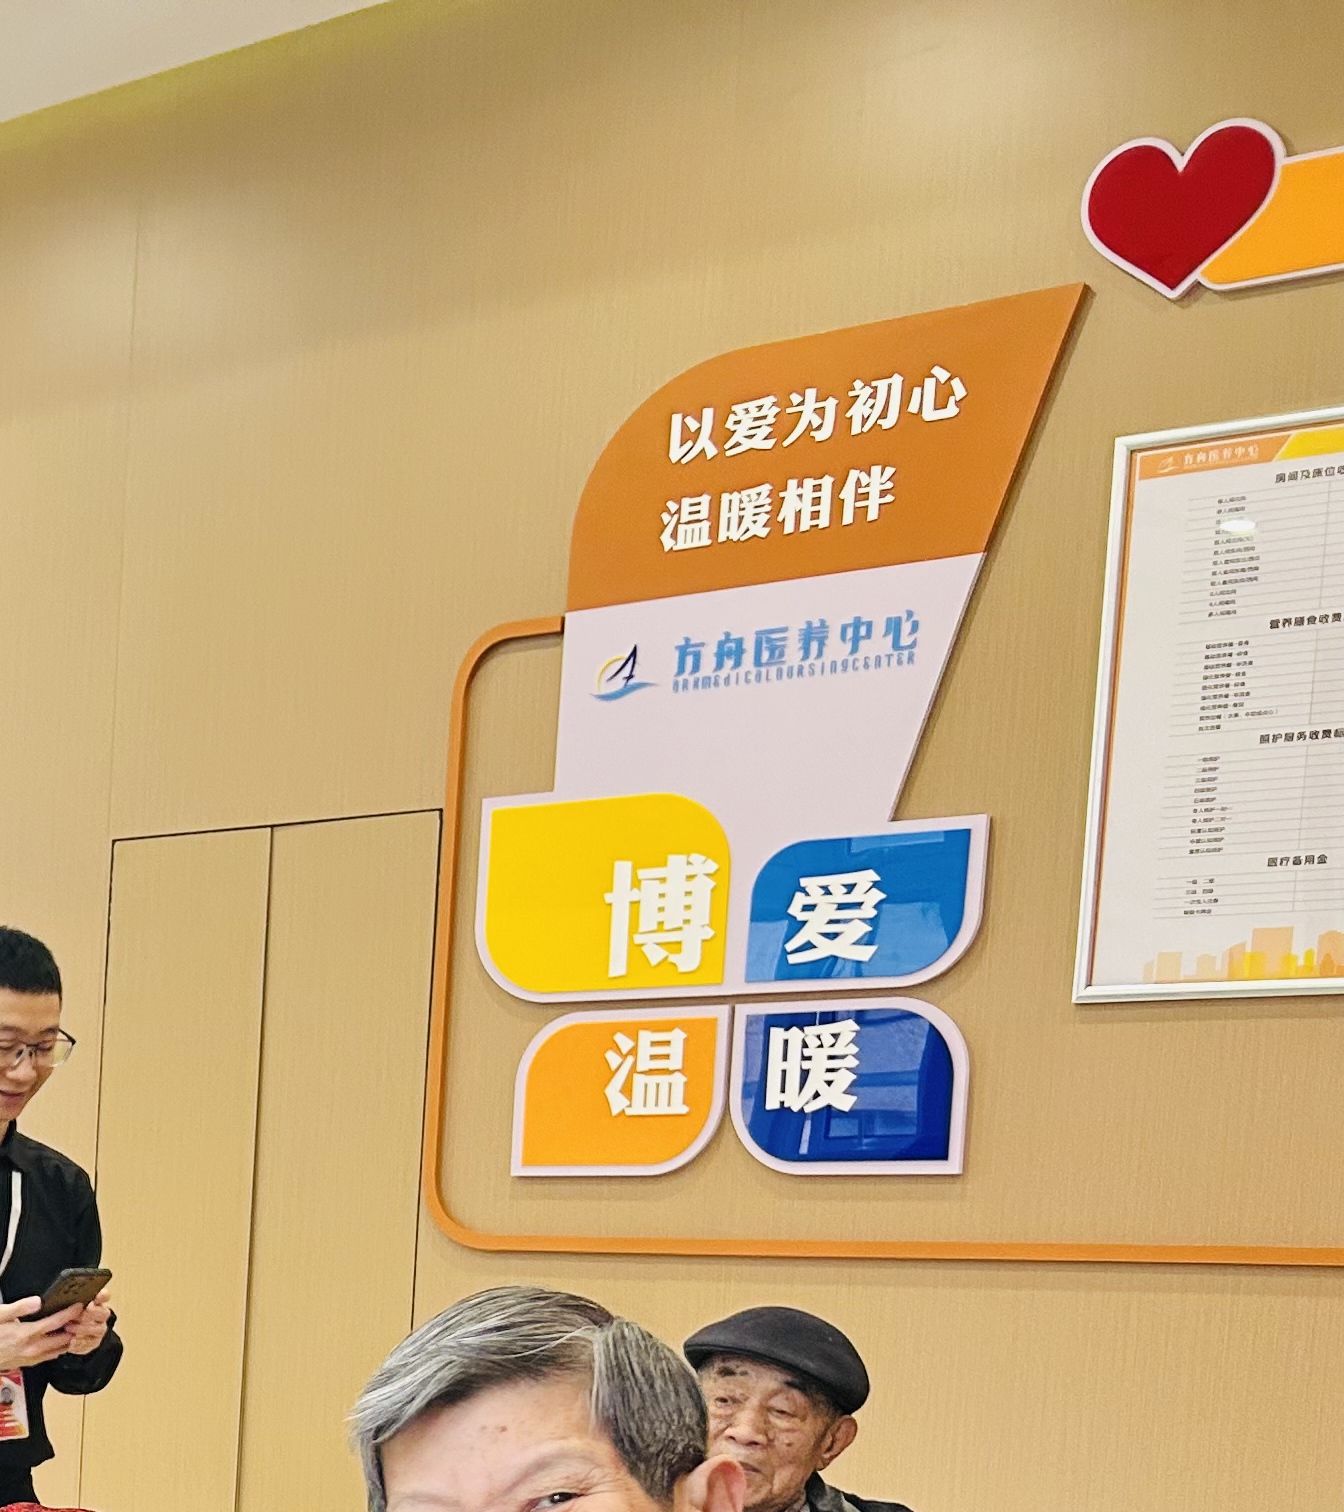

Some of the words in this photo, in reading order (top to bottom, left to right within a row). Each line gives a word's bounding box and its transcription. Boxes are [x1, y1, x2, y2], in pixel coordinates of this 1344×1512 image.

[667, 365, 969, 465] 以爱为初心
[659, 465, 897, 552] 温暖相伴
[674, 610, 919, 677] 方舟医养中心
[604, 854, 719, 978] 博
[784, 869, 888, 964] 爱
[604, 1027, 690, 1117] 温
[765, 1019, 860, 1113] 暖
